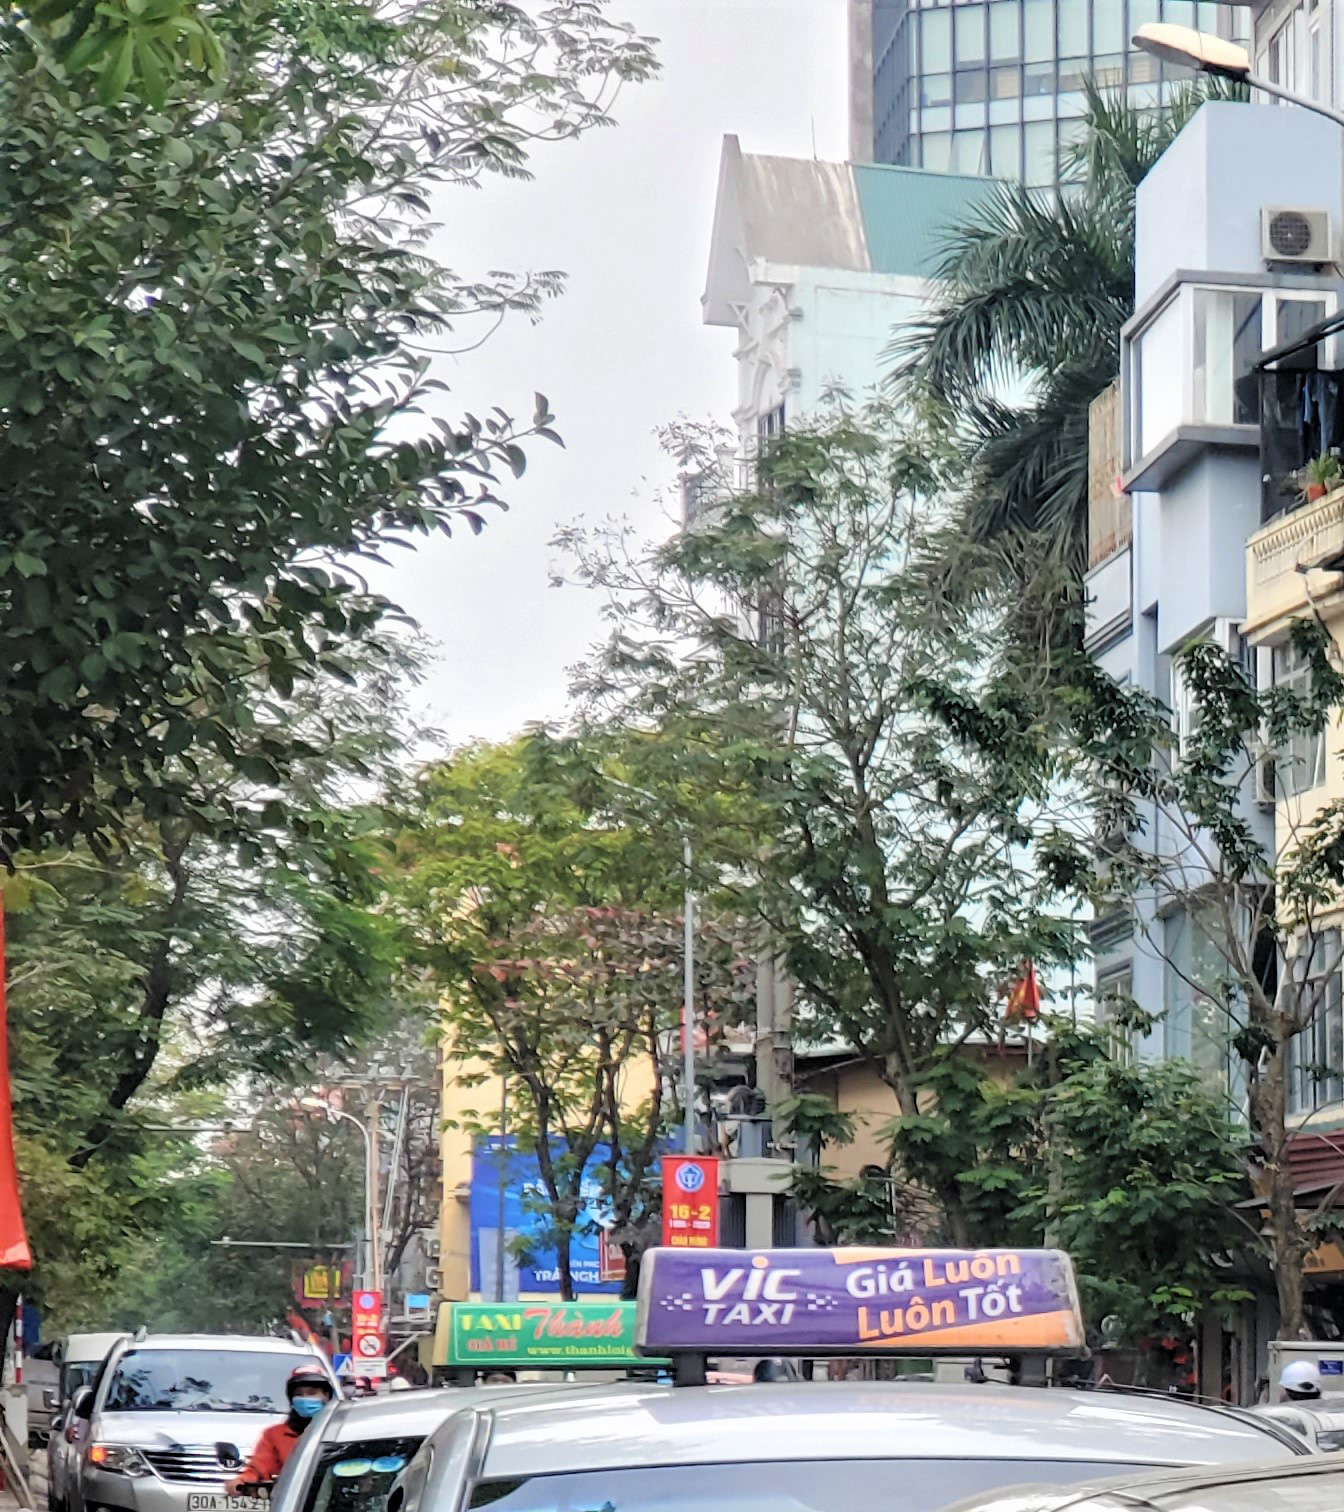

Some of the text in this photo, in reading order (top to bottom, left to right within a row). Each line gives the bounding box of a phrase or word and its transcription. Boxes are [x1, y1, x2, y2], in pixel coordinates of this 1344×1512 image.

[846, 1251, 1020, 1298] Giá Luôn
[459, 1314, 523, 1332] TAXI
[703, 1303, 796, 1326] TAXI
[857, 1281, 1024, 1341] Luôn Tốt
